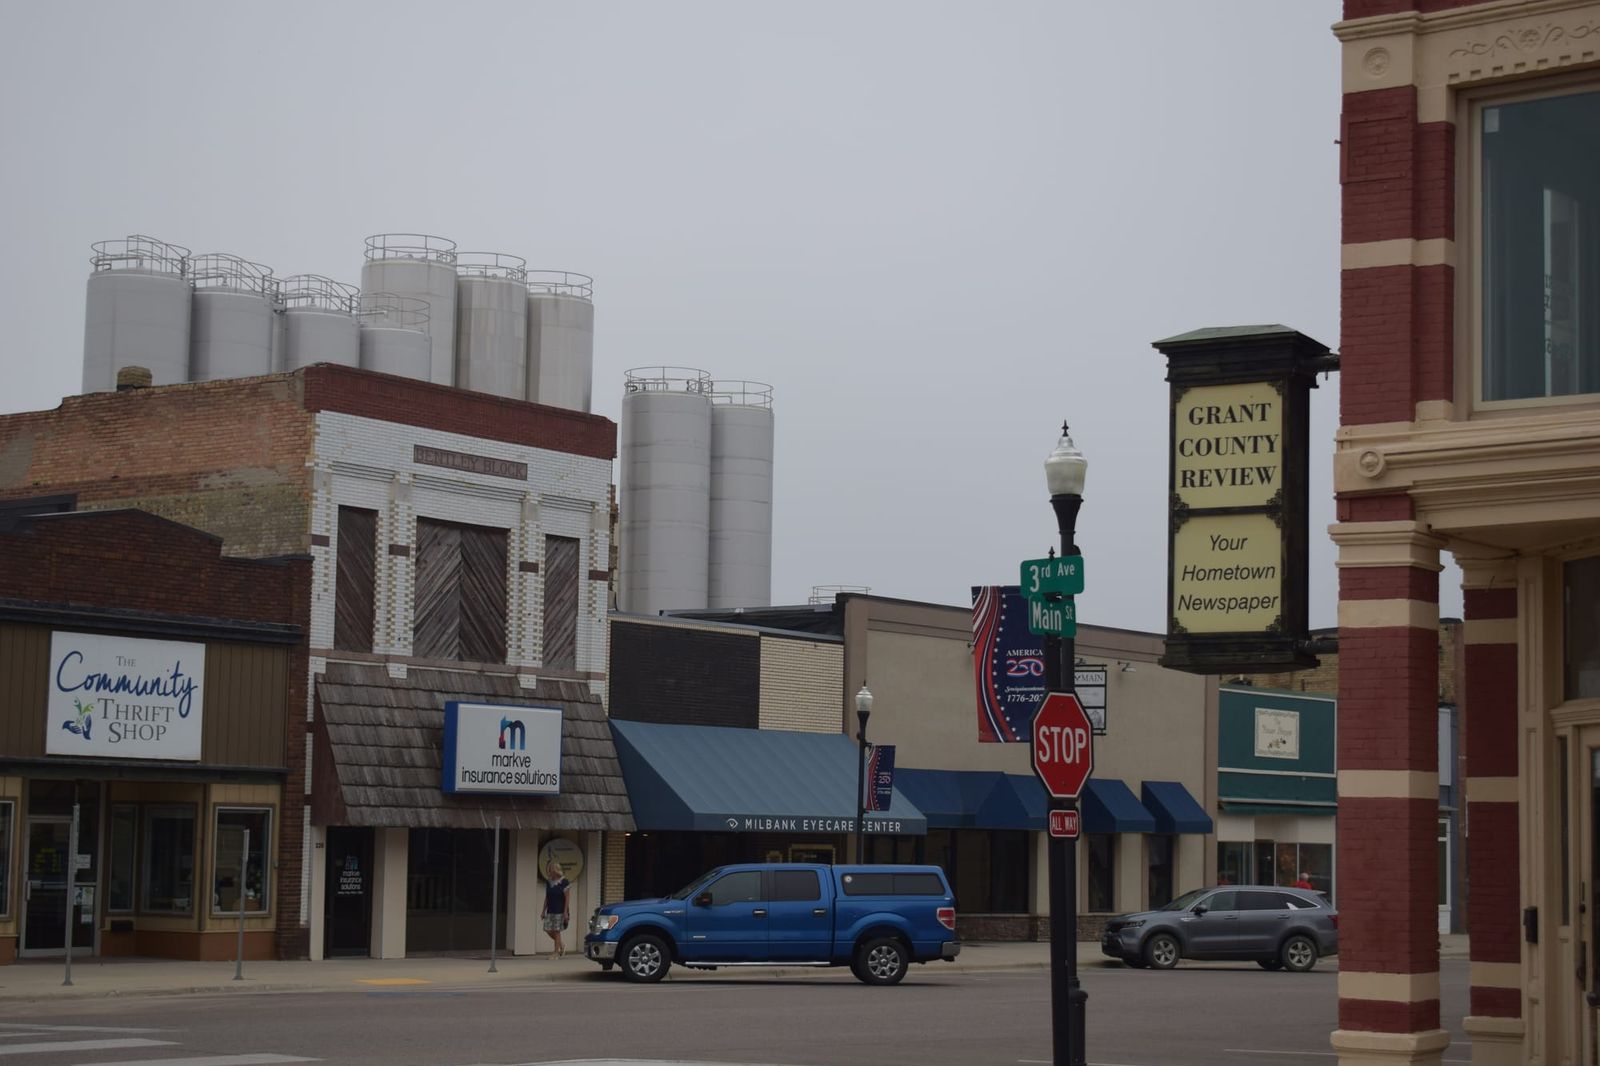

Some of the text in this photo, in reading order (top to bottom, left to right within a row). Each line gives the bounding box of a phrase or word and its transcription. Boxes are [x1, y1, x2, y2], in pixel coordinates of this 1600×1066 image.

[1188, 402, 1272, 425] GRANT
[1178, 433, 1280, 458] COUNTY
[415, 447, 524, 477] BENTLEY BLOCK
[1180, 465, 1277, 488] REVIEW
[1209, 534, 1248, 552] Your
[1029, 562, 1075, 593] 3rd Ave
[1182, 564, 1276, 582] Hometown
[1178, 593, 1279, 613] Newspaper
[1032, 601, 1073, 631] Main St
[116, 656, 136, 667] THE
[1006, 648, 1044, 657] AMERICA
[56, 650, 198, 718] Community
[97, 697, 175, 723] THRIFT
[108, 721, 167, 743] SHOP
[1038, 725, 1087, 764] STOP
[491, 752, 531, 768] markve
[461, 766, 558, 786] insurance solutions
[745, 818, 901, 832] MILBANK EYECARE CENTER
[1051, 815, 1077, 831] ALL WAY
